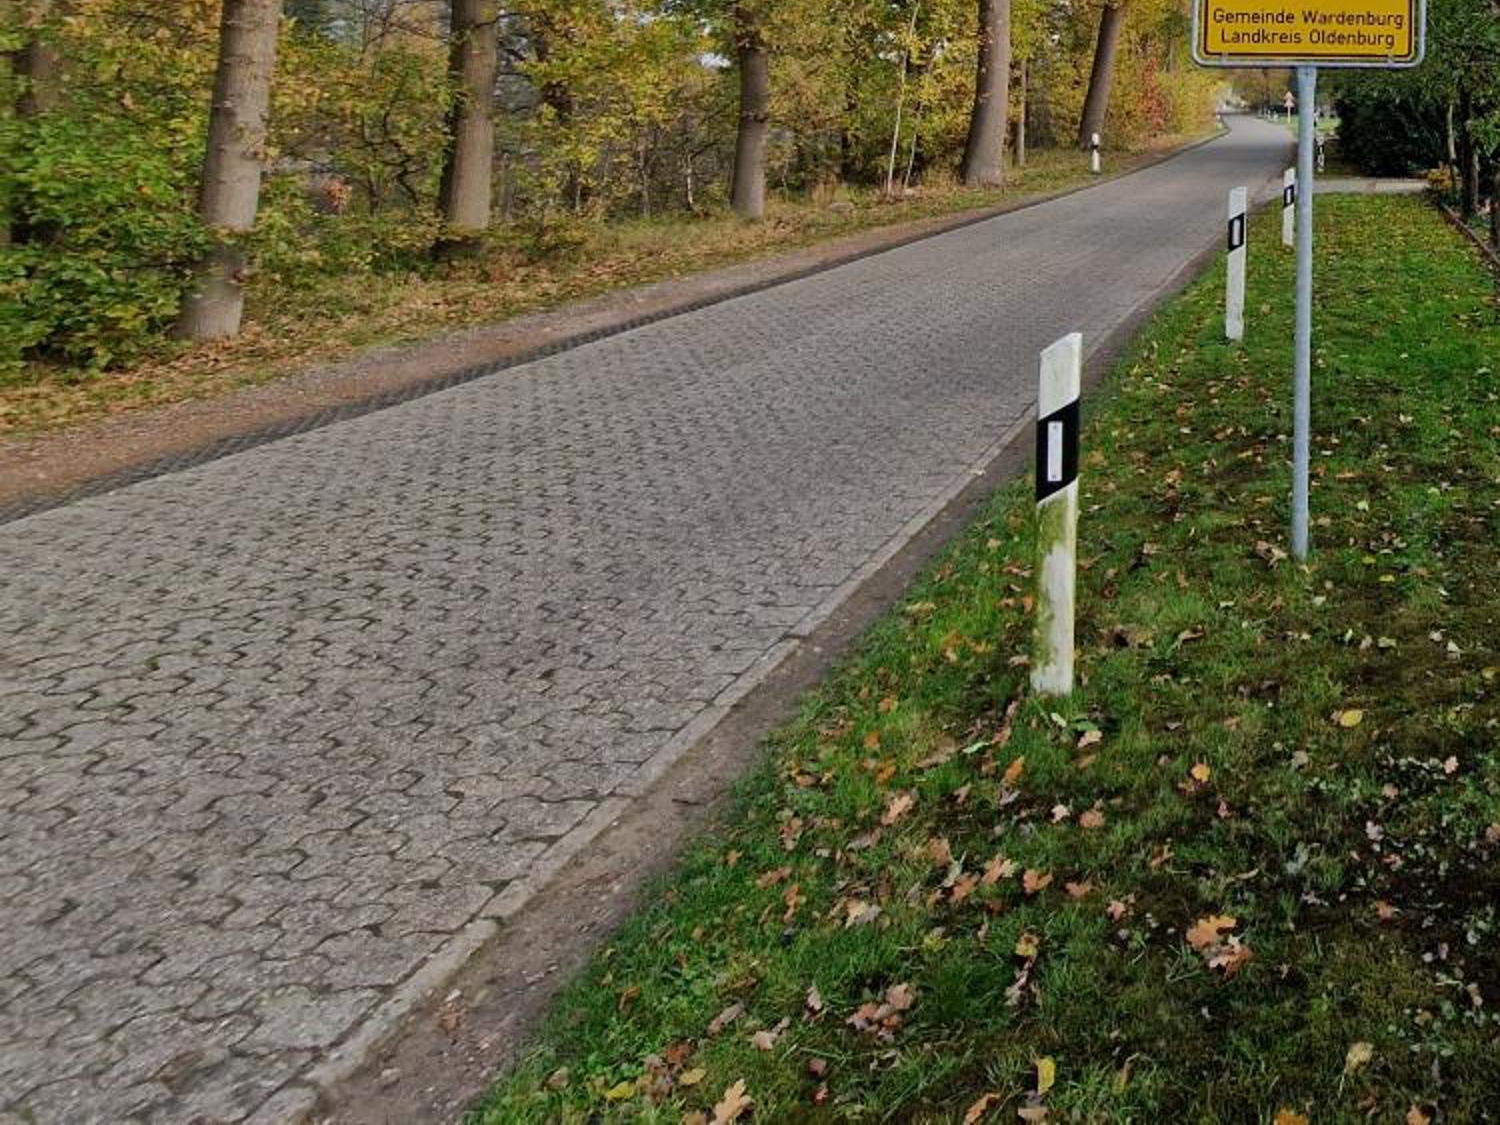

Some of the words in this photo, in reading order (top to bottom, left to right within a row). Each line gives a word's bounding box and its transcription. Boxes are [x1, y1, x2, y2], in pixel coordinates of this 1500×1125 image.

[1213, 7, 1296, 24] Gemeinde
[1302, 9, 1404, 30] Wardenburg
[1221, 28, 1302, 44] Landkreis
[1309, 28, 1395, 49] Oldenburg
